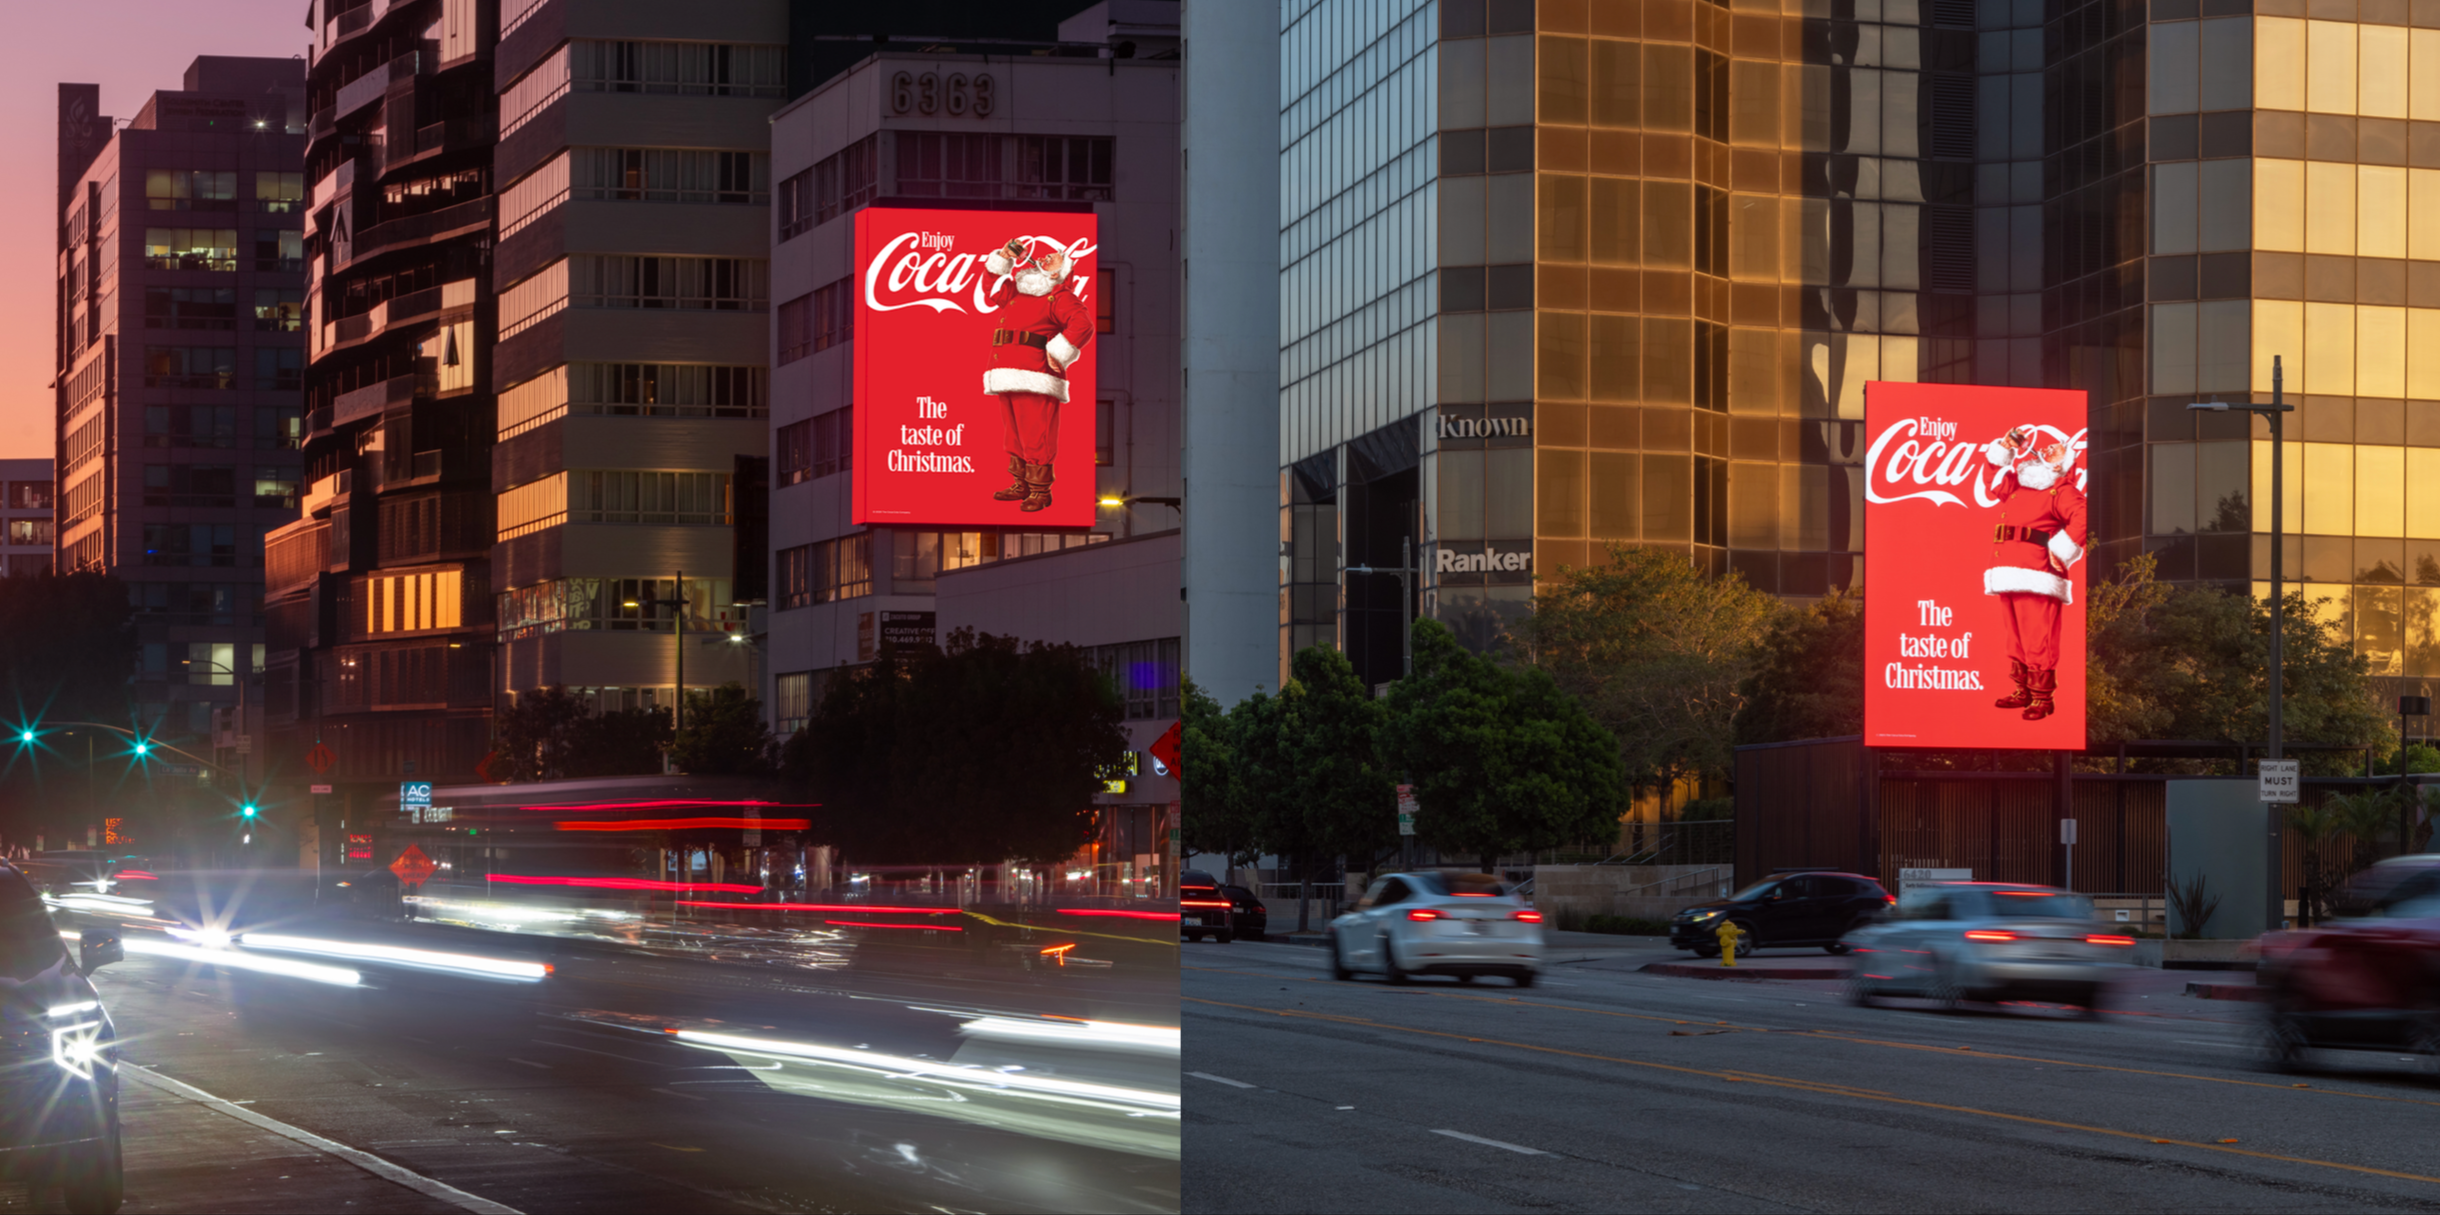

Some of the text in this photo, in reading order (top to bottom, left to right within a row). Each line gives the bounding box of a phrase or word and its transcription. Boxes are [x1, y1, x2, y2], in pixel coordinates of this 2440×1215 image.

[892, 71, 994, 116] 6363
[921, 231, 955, 251] Enjoy
[916, 396, 947, 419] The
[901, 423, 964, 446] taste of
[1439, 413, 1529, 438] Known
[1918, 416, 1957, 441] Enjoy
[888, 449, 975, 473] Christmas.
[1437, 547, 1531, 573] Ranker
[1918, 599, 1953, 627] The
[884, 627, 919, 635] CREATIVE
[1900, 632, 1973, 659] taste of
[1885, 662, 1985, 691] Christmas.
[406, 785, 430, 797] AC
[2265, 777, 2292, 785] MUST
[1904, 870, 1931, 880] 6420
